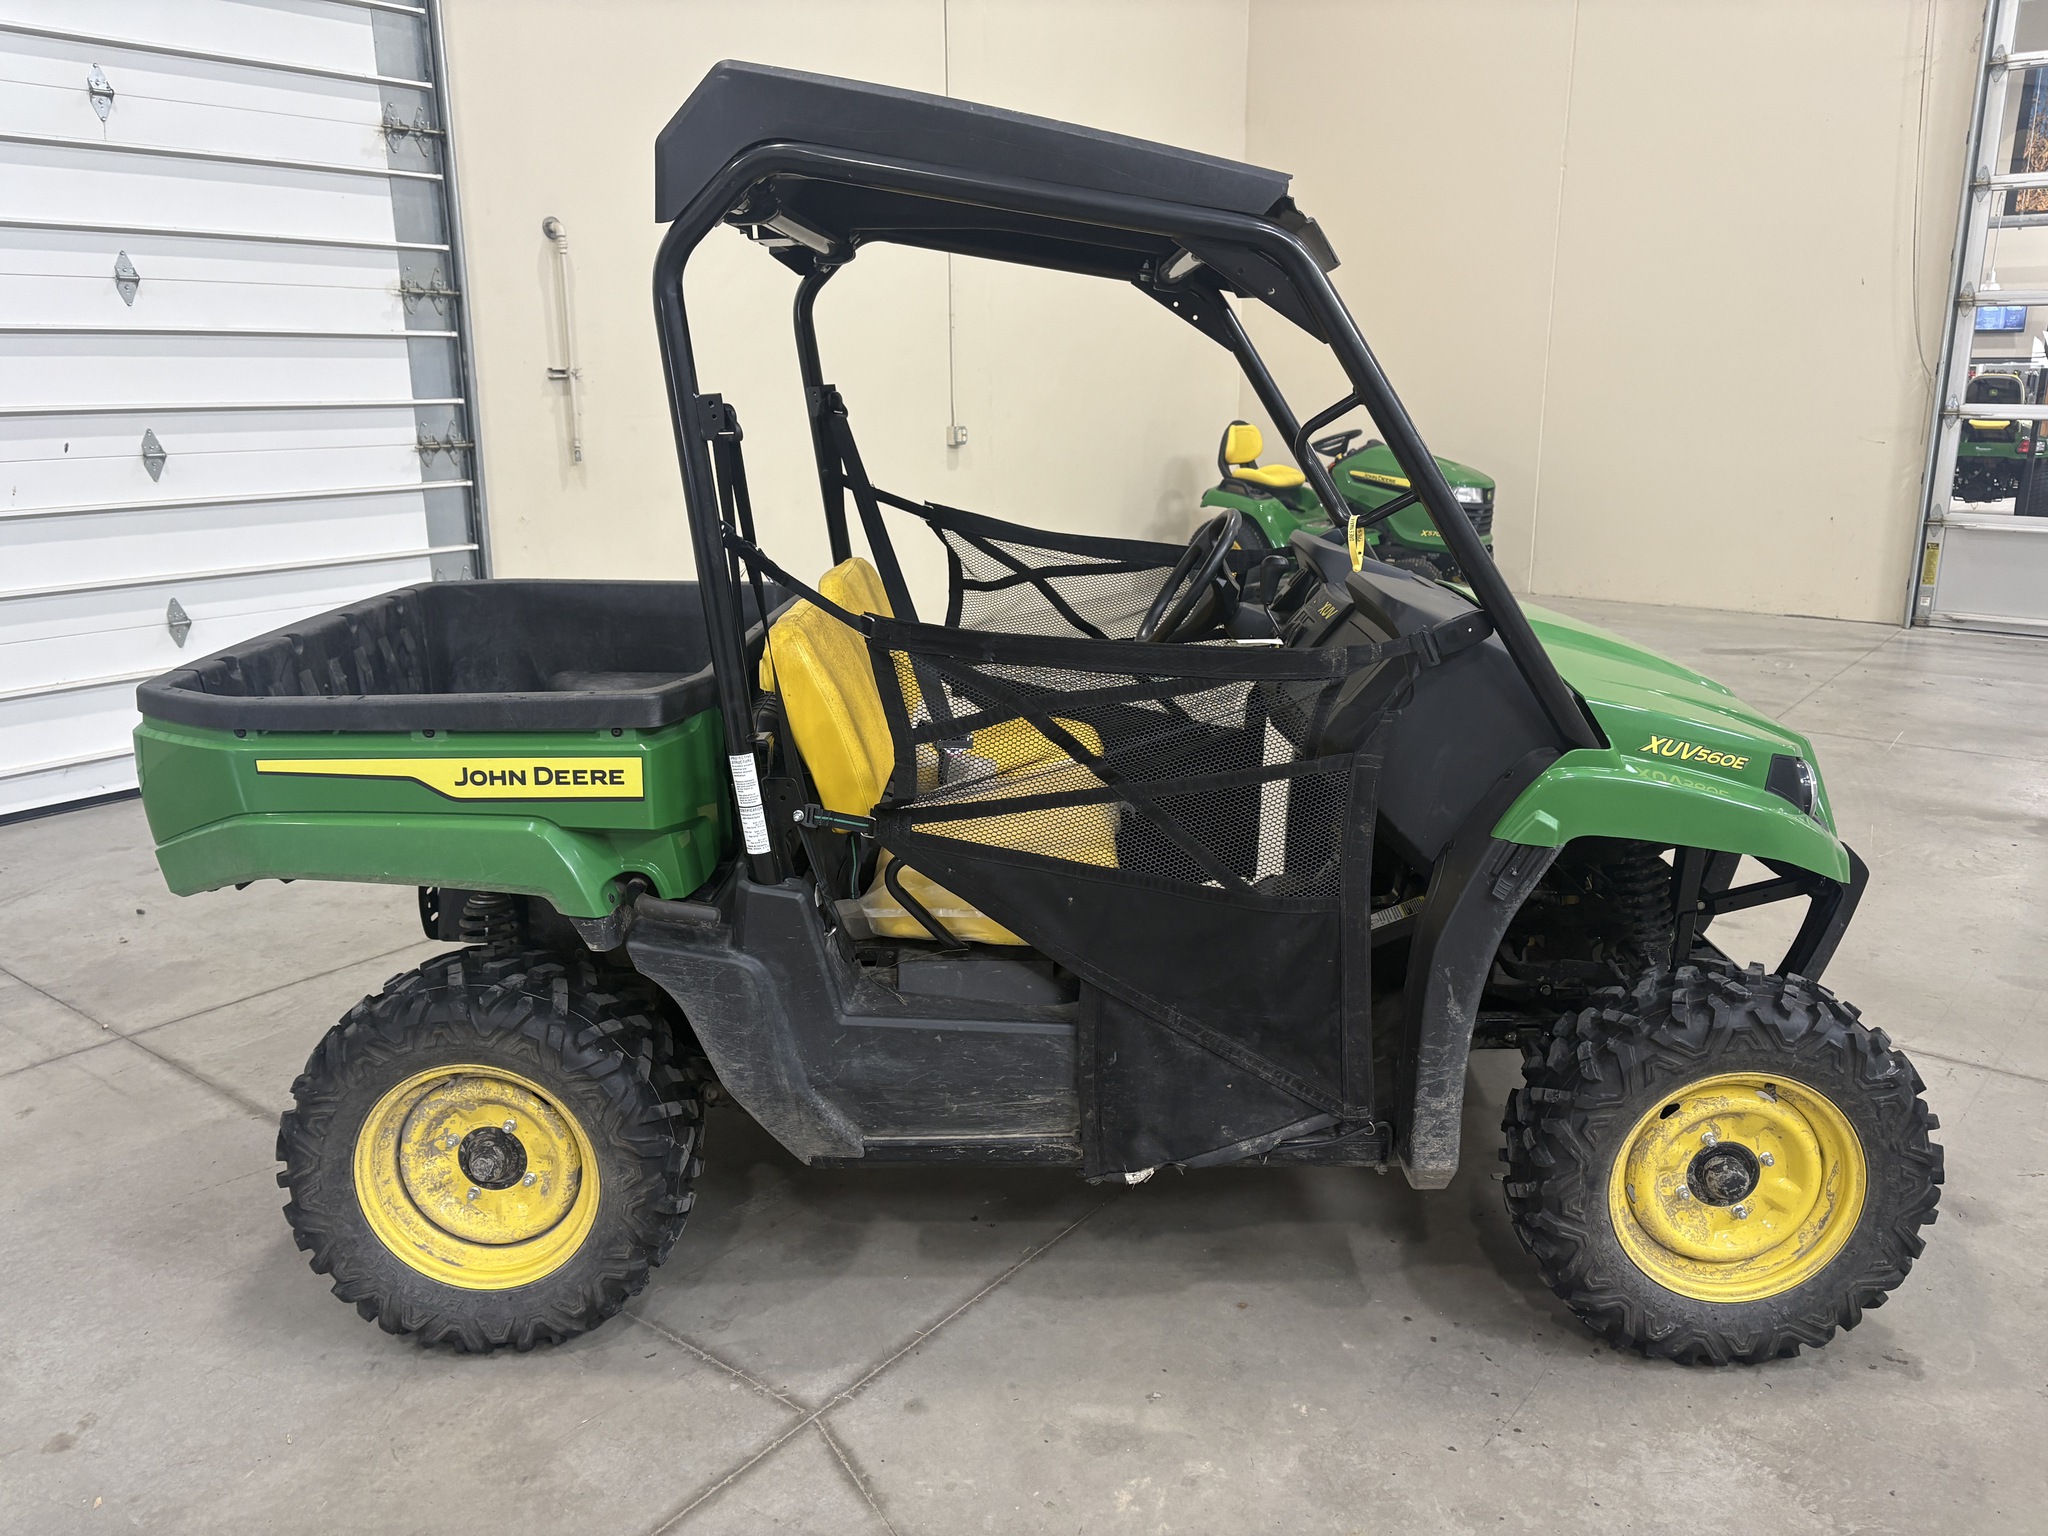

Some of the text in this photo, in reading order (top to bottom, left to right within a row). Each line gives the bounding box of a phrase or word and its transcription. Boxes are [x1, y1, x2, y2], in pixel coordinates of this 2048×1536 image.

[1317, 601, 1339, 619] XUV
[1638, 734, 1751, 771] XUV560E
[454, 766, 625, 787] JOHN DEERE
